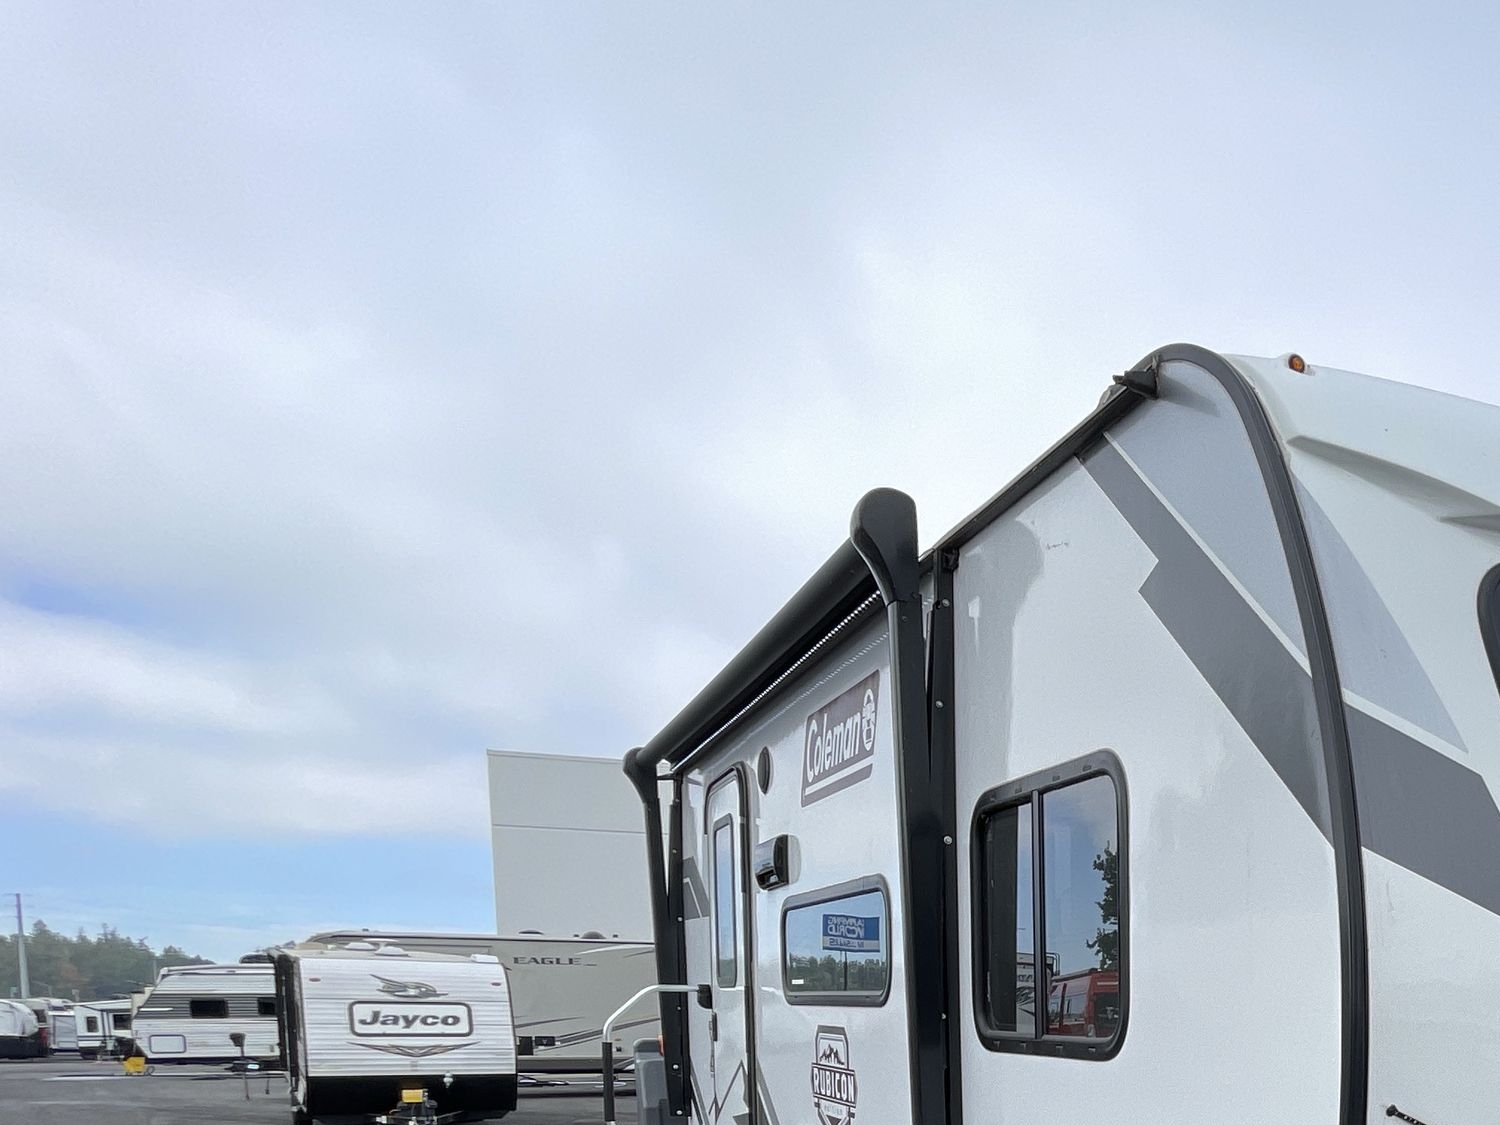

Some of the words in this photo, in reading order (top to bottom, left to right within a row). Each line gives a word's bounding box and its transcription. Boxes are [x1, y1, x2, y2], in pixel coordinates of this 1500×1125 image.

[806, 712, 861, 783] Coleman
[513, 956, 582, 966] EAGLE
[358, 1010, 461, 1029] Jayco
[813, 1067, 855, 1103] RUBICON
